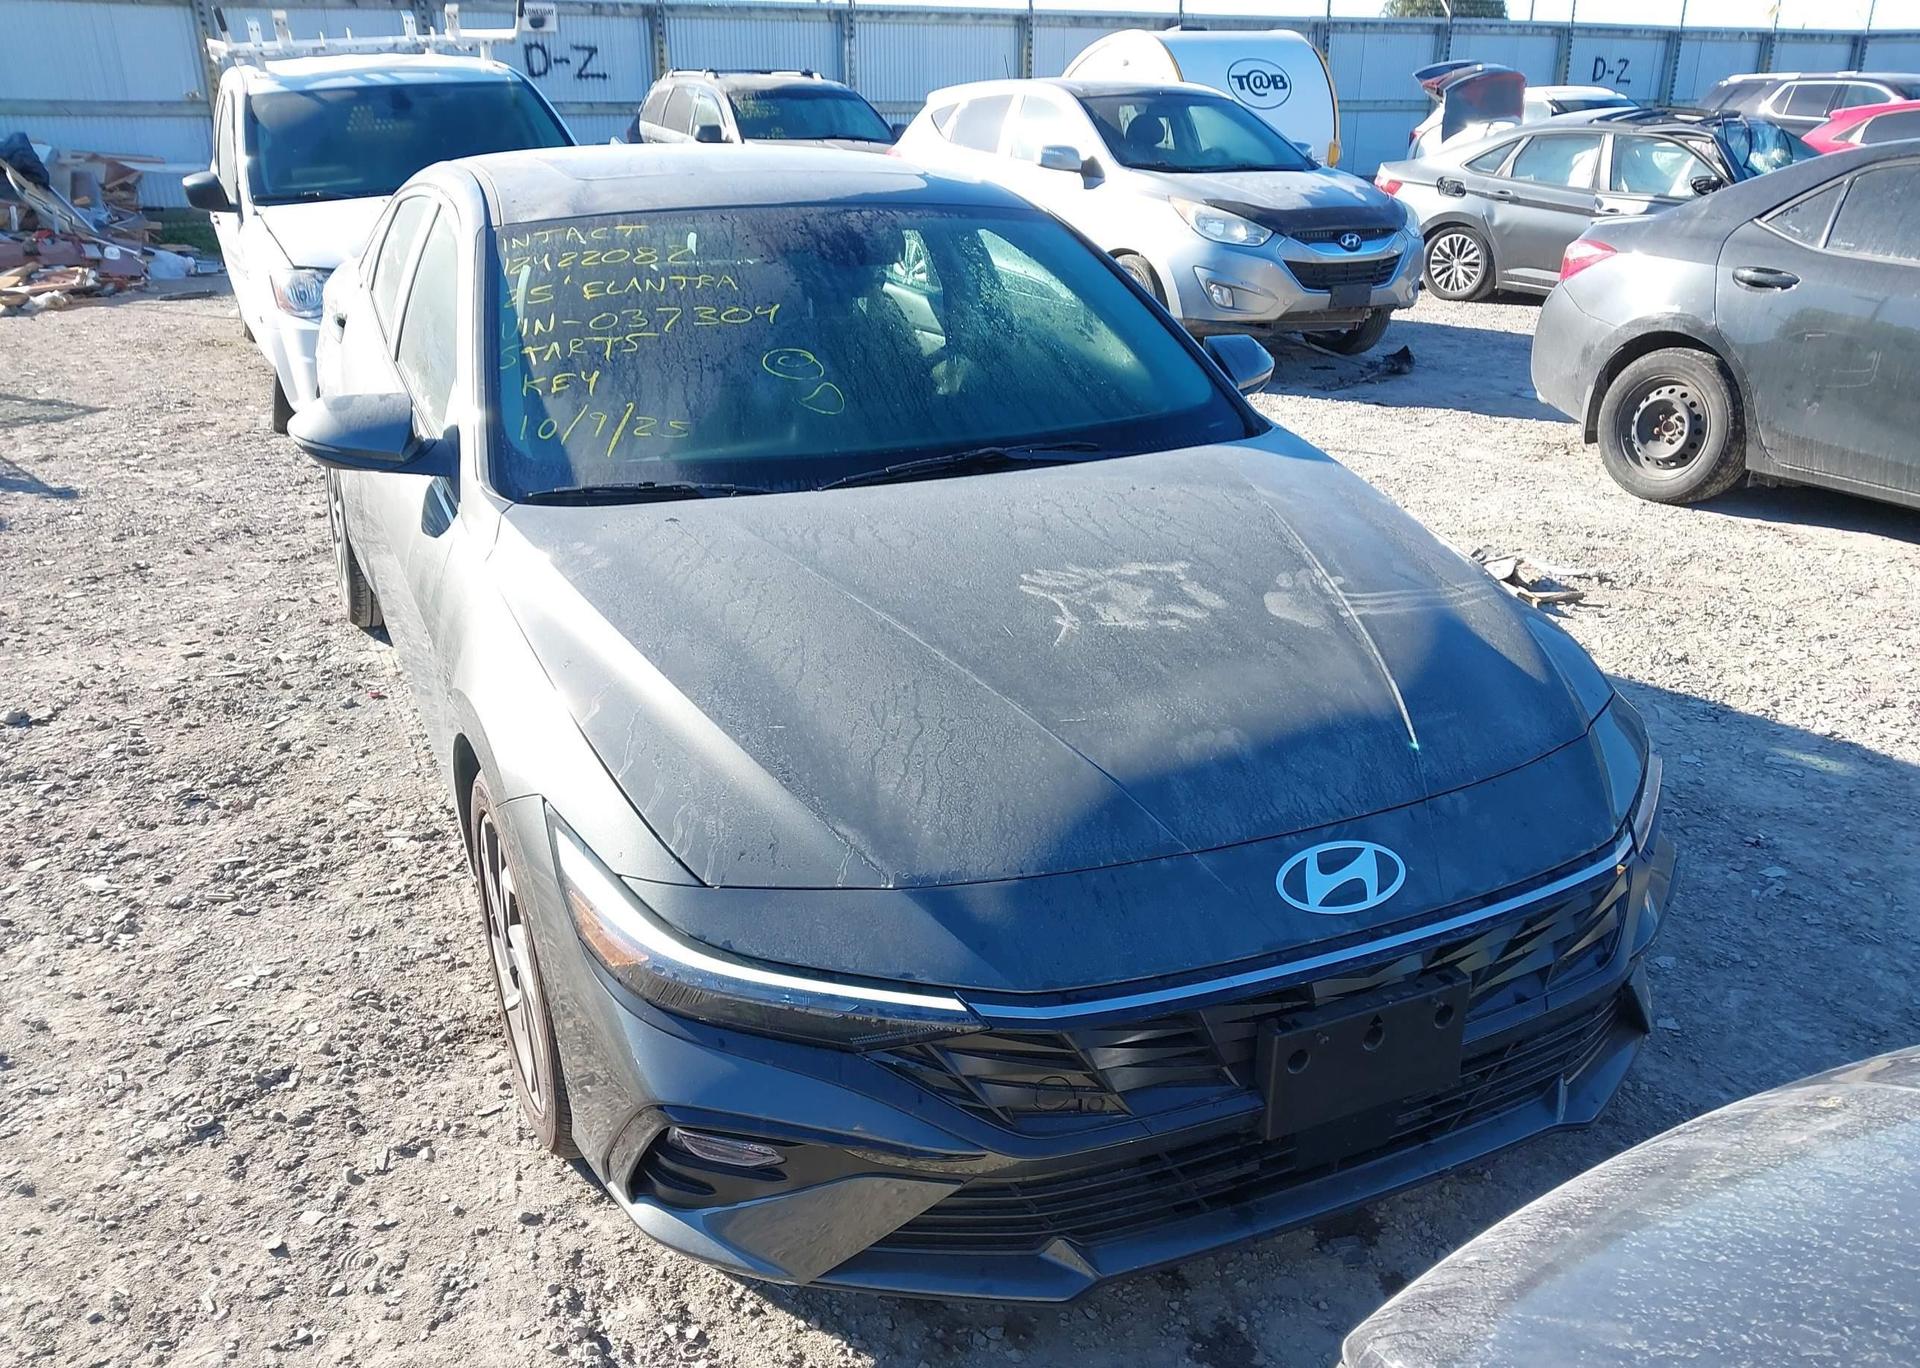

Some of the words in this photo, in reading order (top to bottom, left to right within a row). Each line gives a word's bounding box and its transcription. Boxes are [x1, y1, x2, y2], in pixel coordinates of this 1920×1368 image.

[523, 41, 608, 79] D-Z
[1231, 69, 1288, 97] T@B
[502, 225, 649, 252] INTACT
[583, 274, 739, 300] ELANTRA
[499, 332, 660, 369] STARTS
[522, 370, 600, 397] KEY
